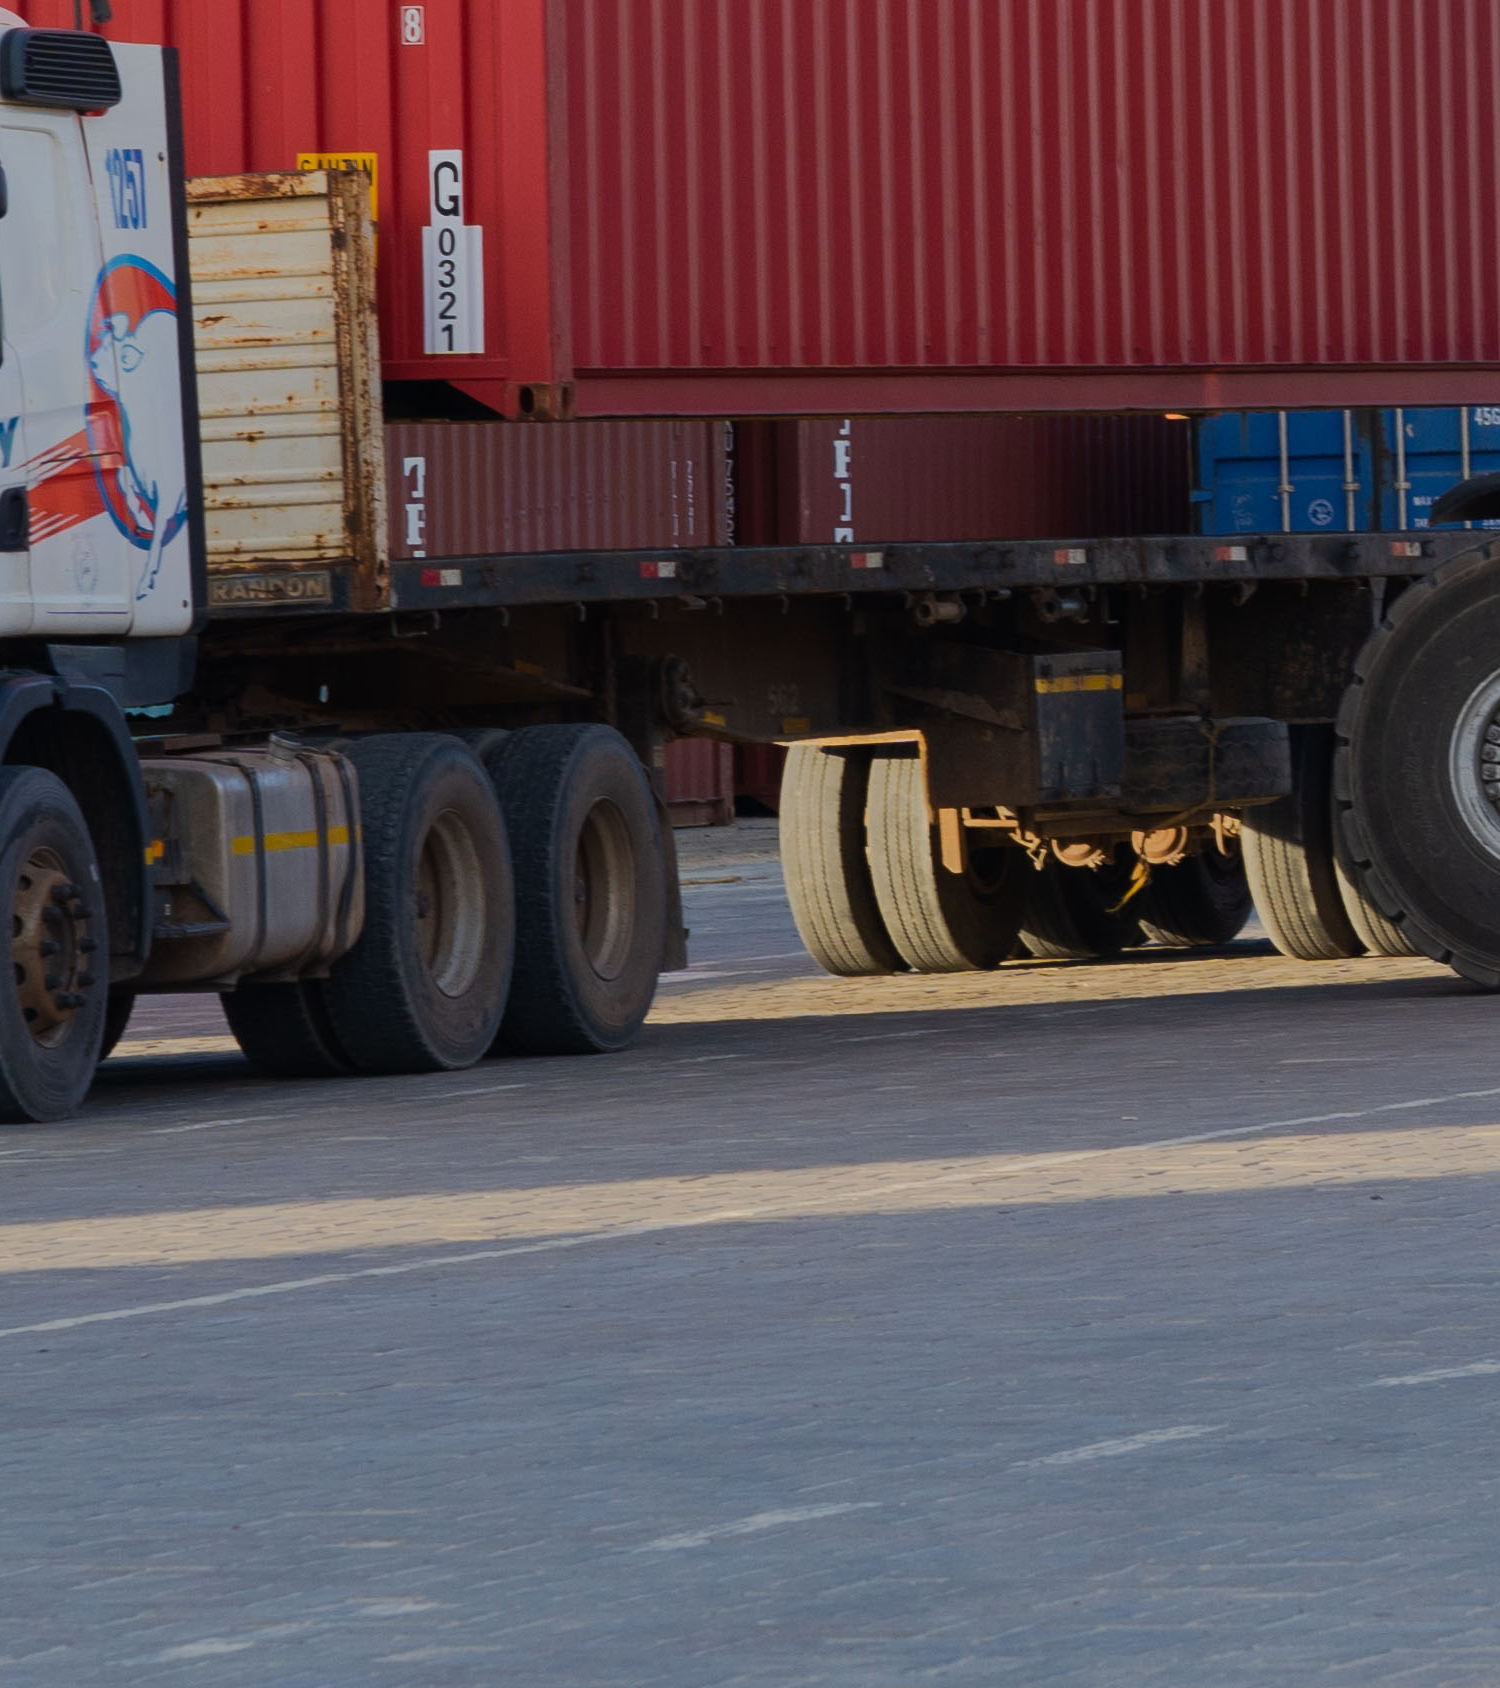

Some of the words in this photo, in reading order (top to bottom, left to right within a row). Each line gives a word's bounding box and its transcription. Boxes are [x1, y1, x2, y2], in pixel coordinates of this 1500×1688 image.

[400, 5, 425, 46] 8
[105, 148, 149, 230] 1257
[433, 160, 461, 217] G
[437, 227, 458, 353] 0321
